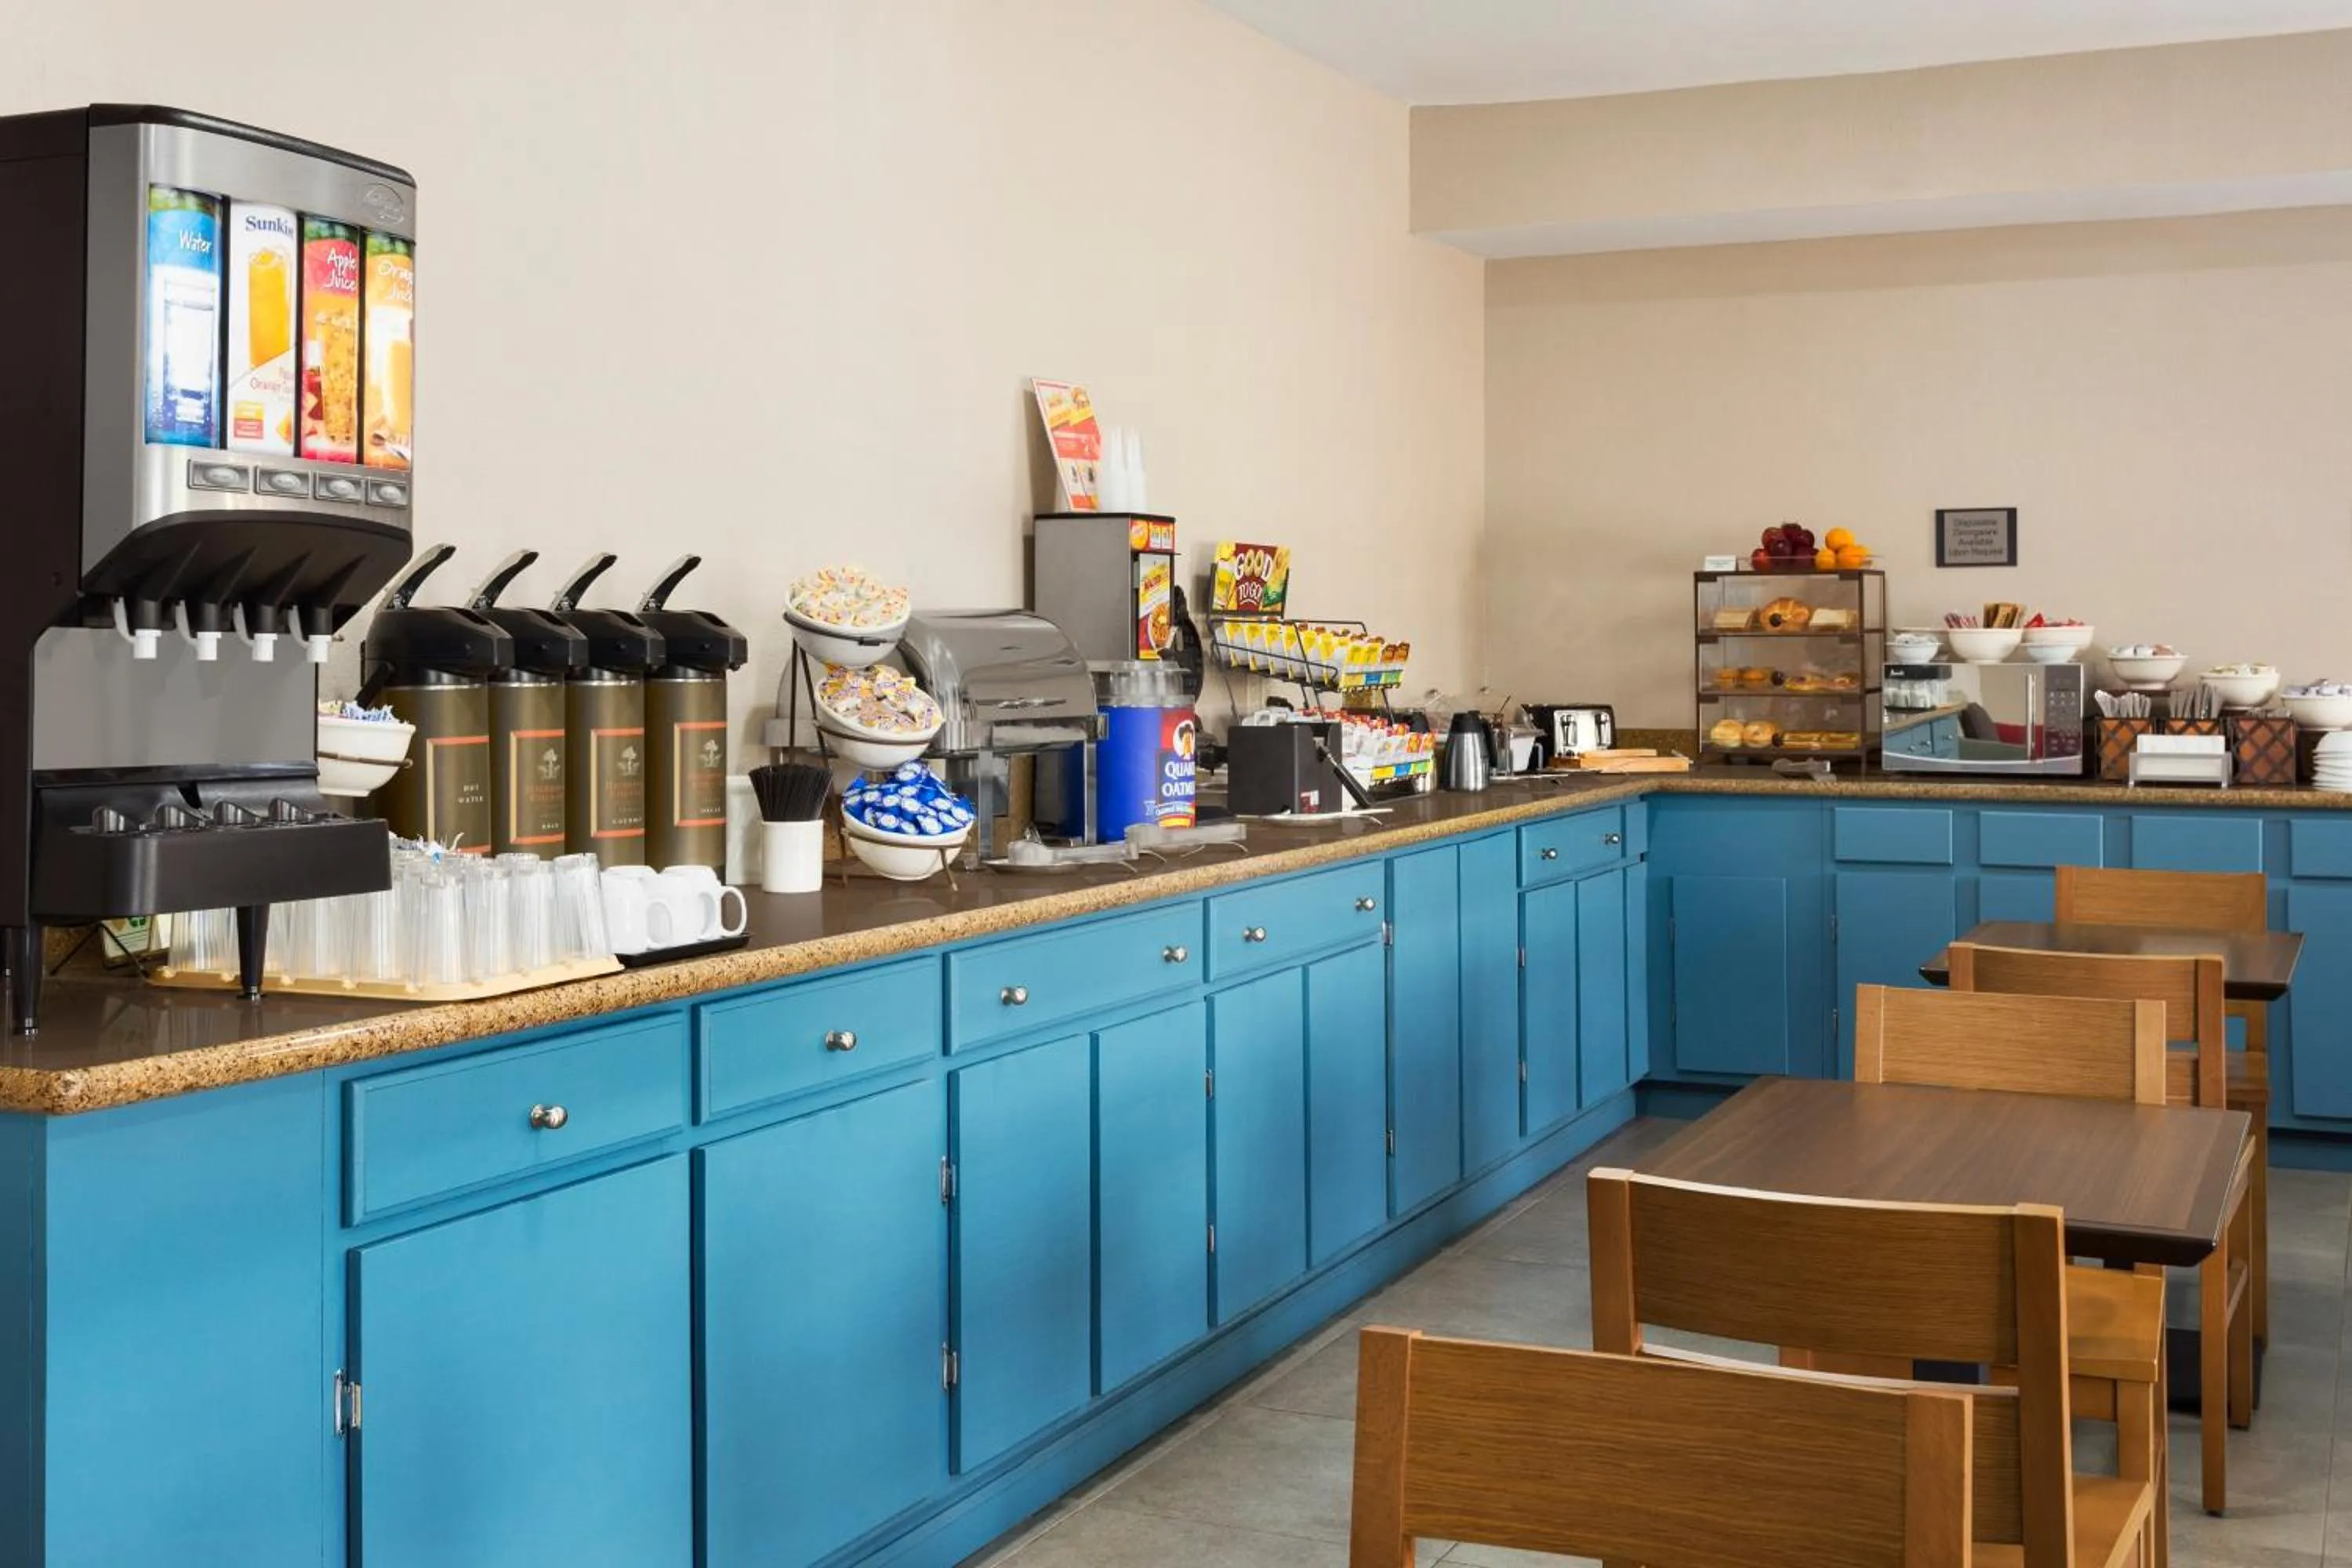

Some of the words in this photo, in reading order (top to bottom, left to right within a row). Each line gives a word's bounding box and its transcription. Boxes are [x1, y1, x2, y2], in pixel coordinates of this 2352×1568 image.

[179, 227, 213, 255] Water
[327, 247, 357, 277] Apple
[325, 268, 356, 291] Juice
[1234, 548, 1272, 583] GOOD
[1239, 582, 1250, 601] TO
[463, 783, 480, 792] HOT
[457, 795, 484, 804] WATER
